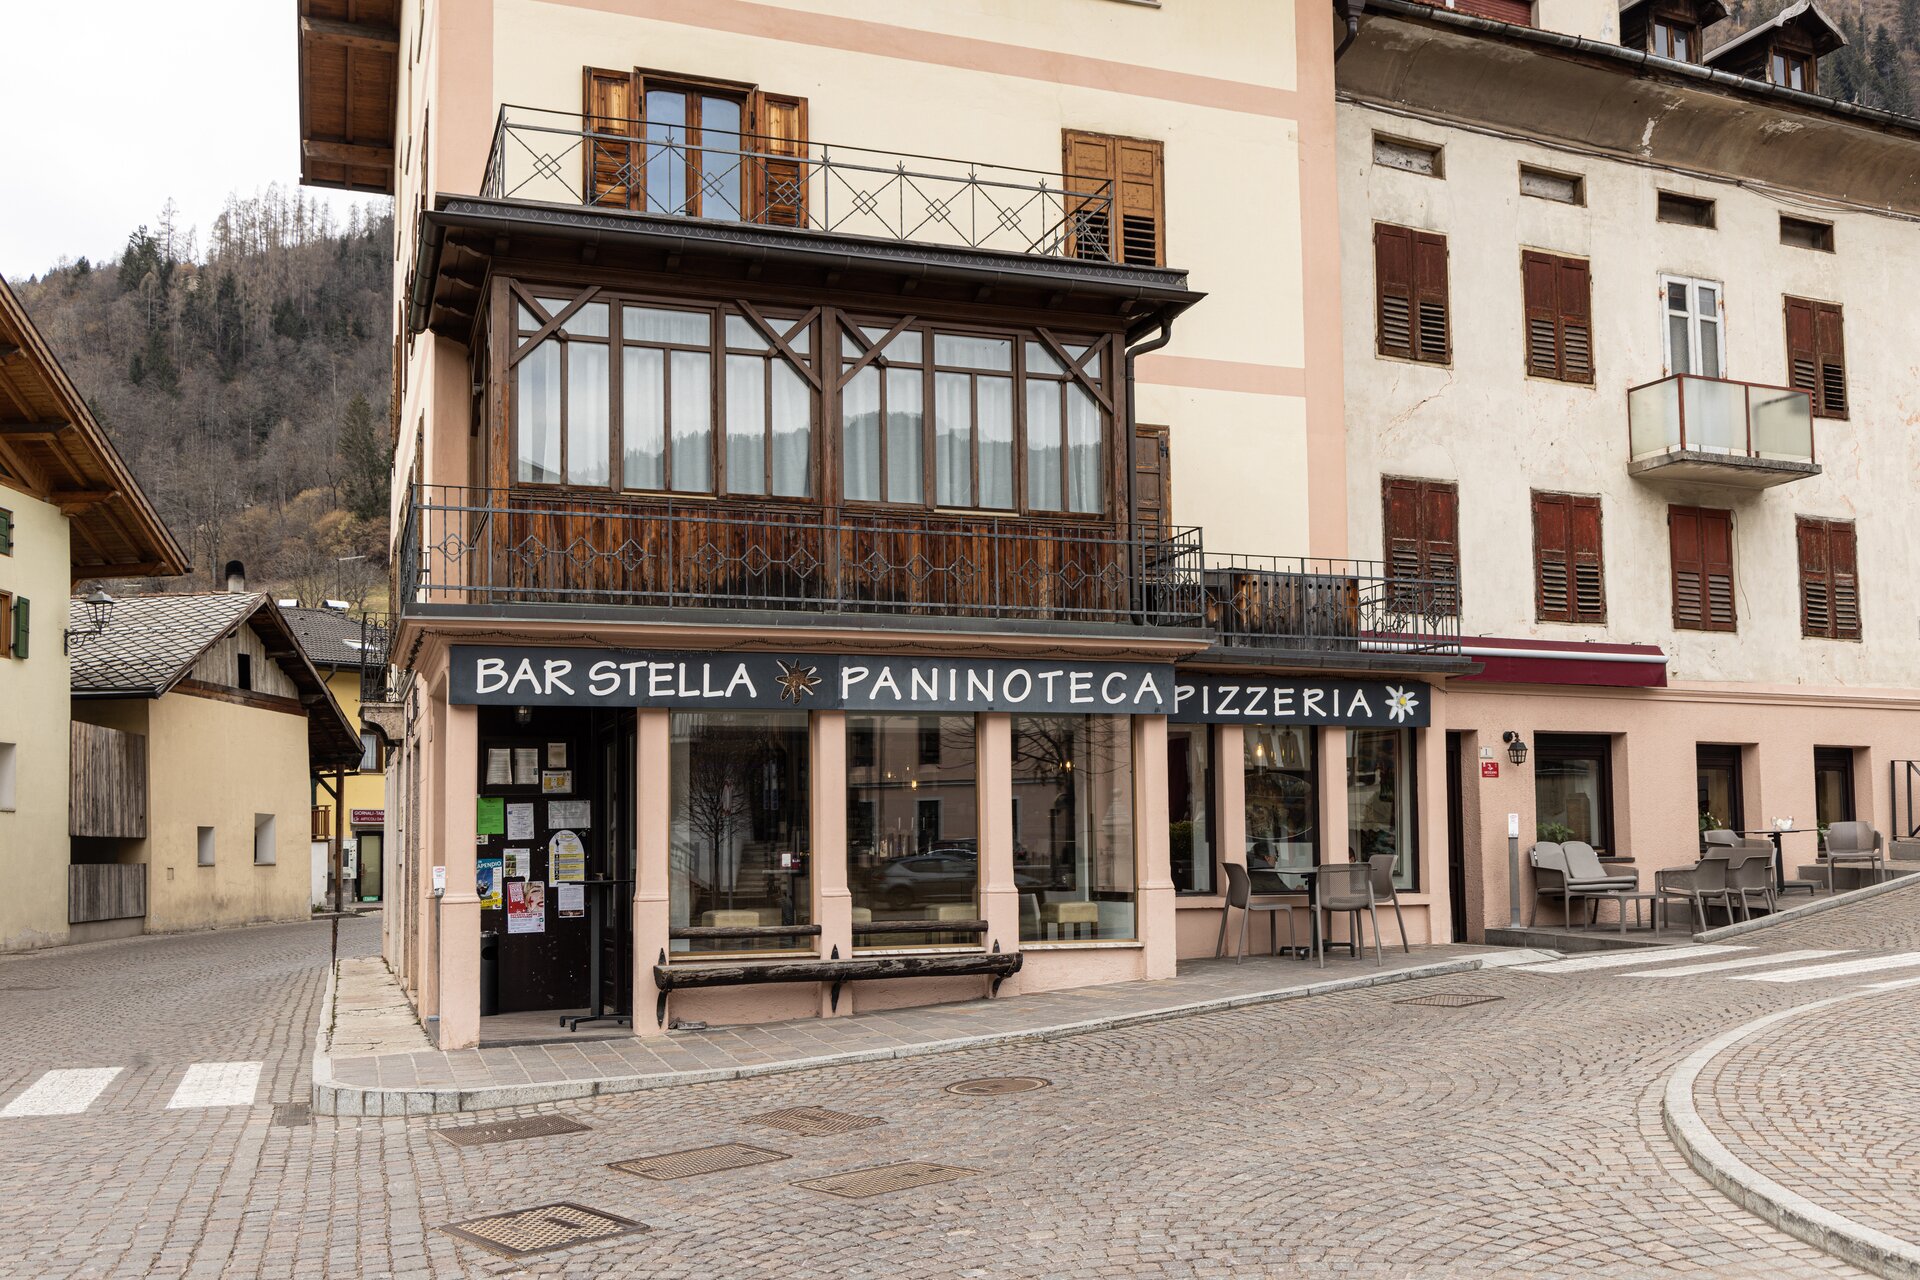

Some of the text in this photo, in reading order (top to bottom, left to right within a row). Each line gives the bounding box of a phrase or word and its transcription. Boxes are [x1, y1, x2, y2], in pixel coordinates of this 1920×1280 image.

[476, 658, 758, 699] BAR STELLA
[841, 666, 1164, 705] PANINOTECA
[1174, 684, 1373, 718] PIZZERIA
